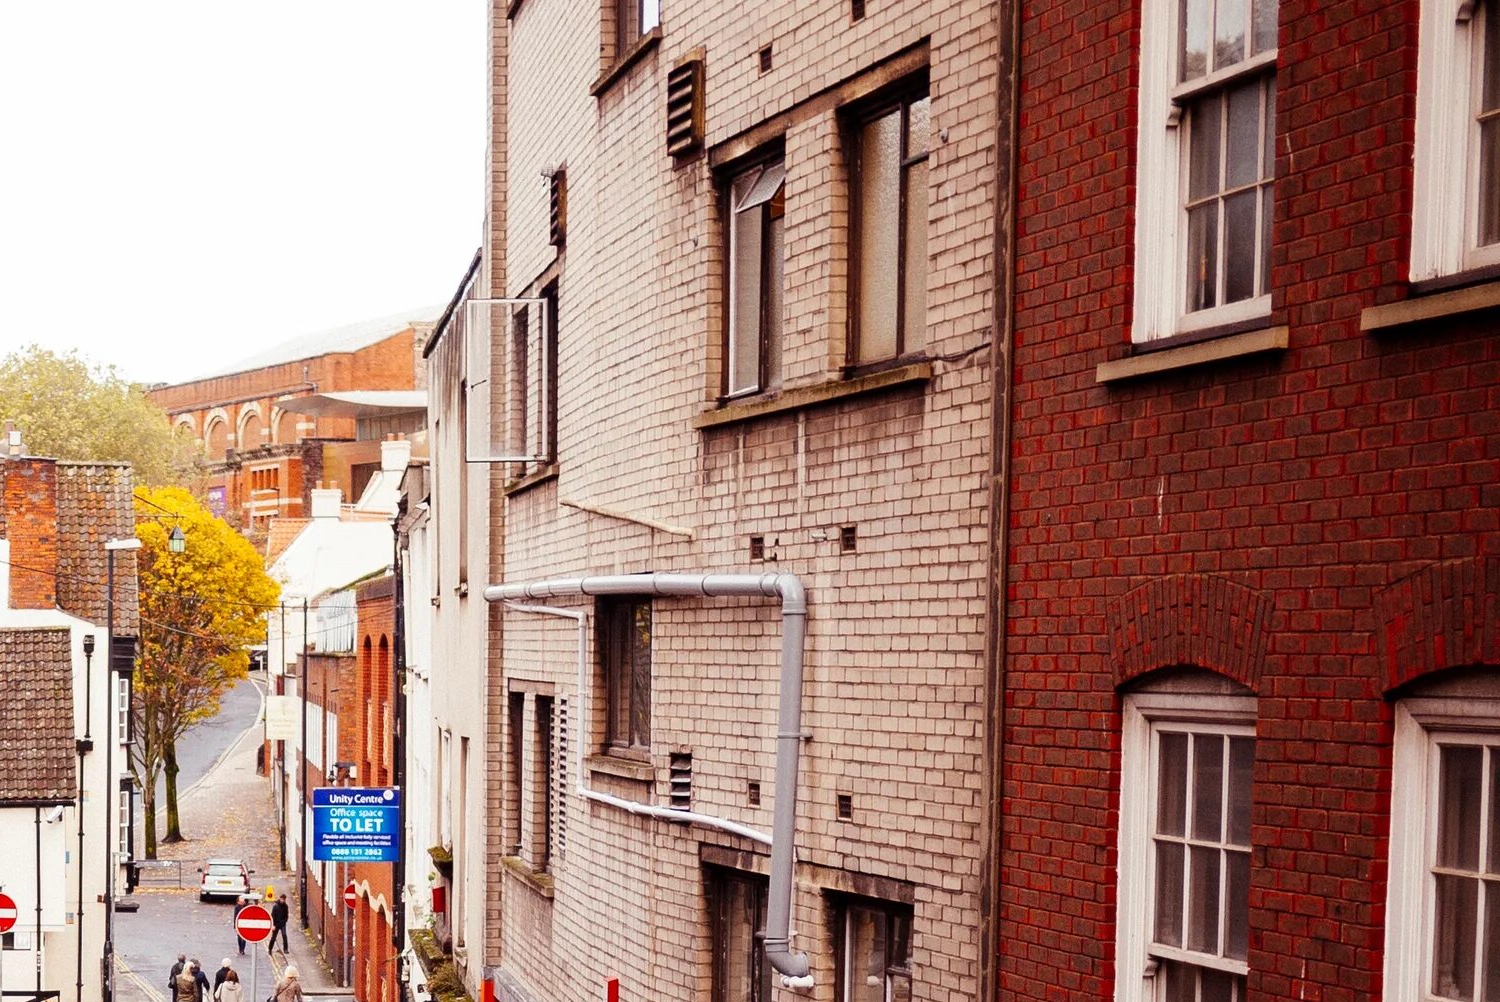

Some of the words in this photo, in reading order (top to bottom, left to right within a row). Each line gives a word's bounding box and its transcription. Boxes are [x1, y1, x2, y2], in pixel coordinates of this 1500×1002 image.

[329, 794, 353, 806] Unity
[354, 794, 384, 804] Centre
[330, 808, 356, 817] Office
[358, 810, 384, 819] space
[329, 817, 353, 832] TO
[355, 818, 384, 832] LET
